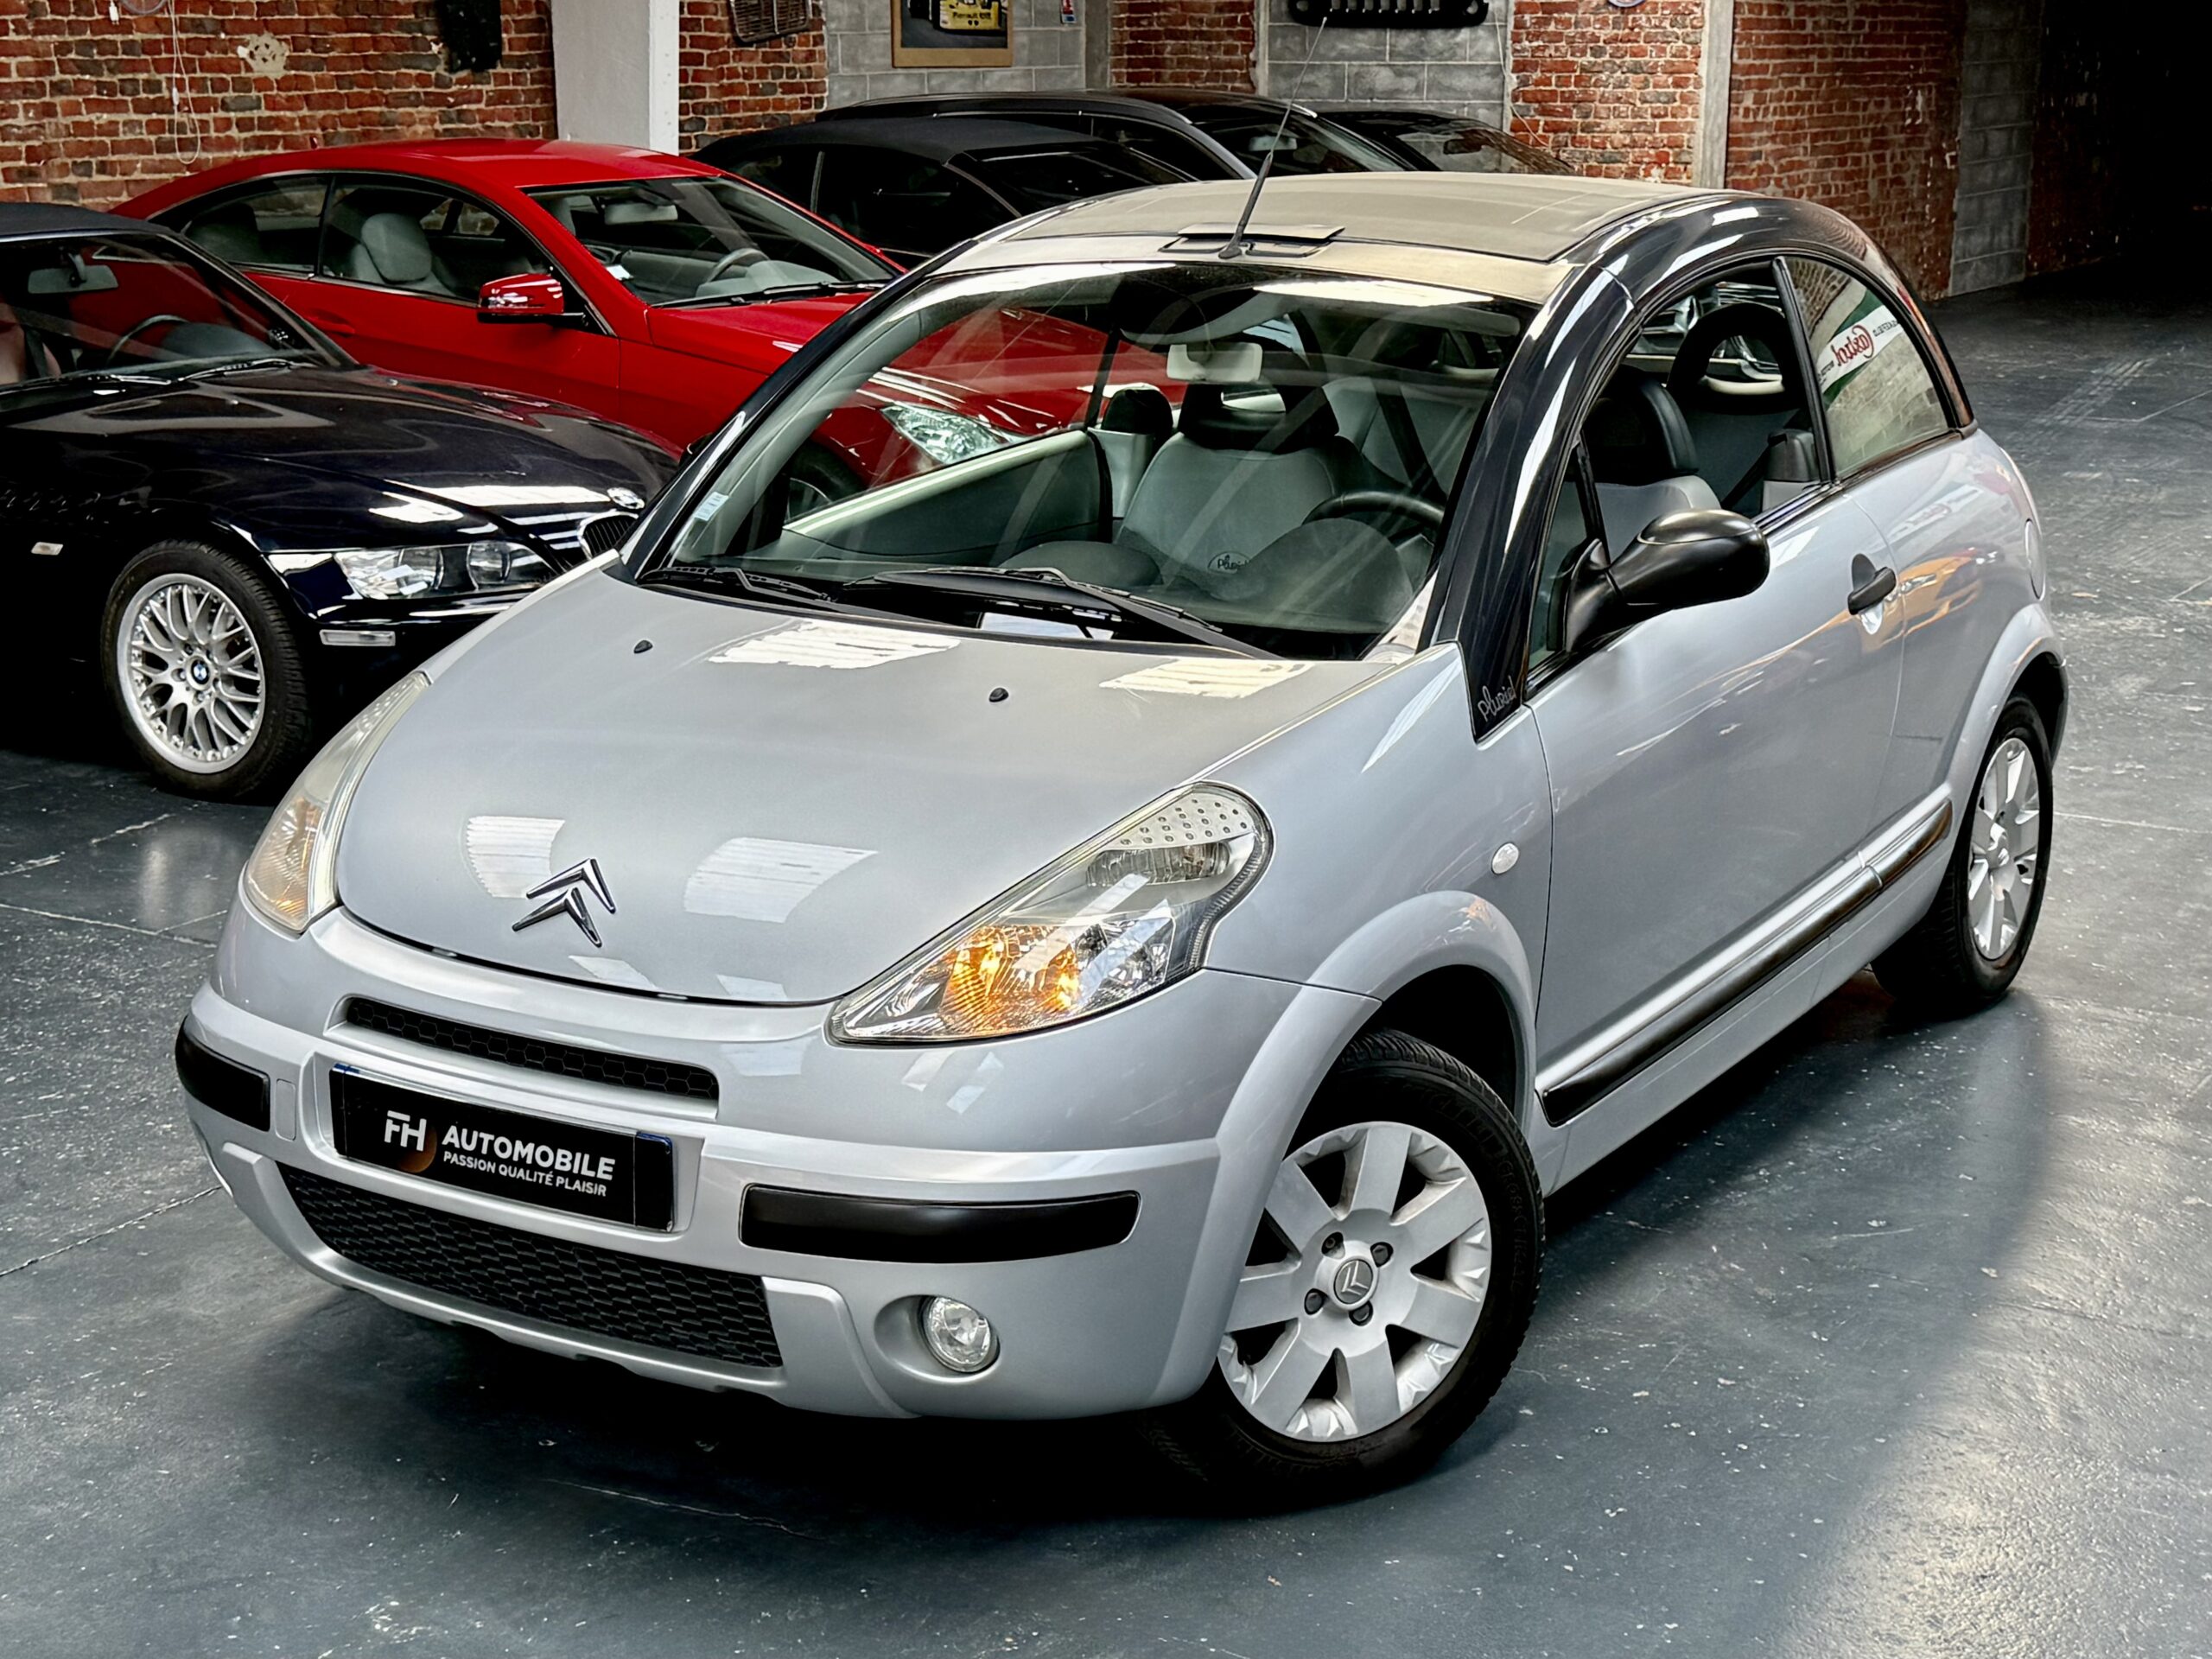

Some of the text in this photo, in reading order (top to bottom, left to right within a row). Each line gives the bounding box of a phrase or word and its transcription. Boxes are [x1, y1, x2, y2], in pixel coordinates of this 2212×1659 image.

[384, 1109, 617, 1181] FH AUTOMOBILE
[443, 1150, 607, 1198] PASSION QUALITÉ PLAISIR
